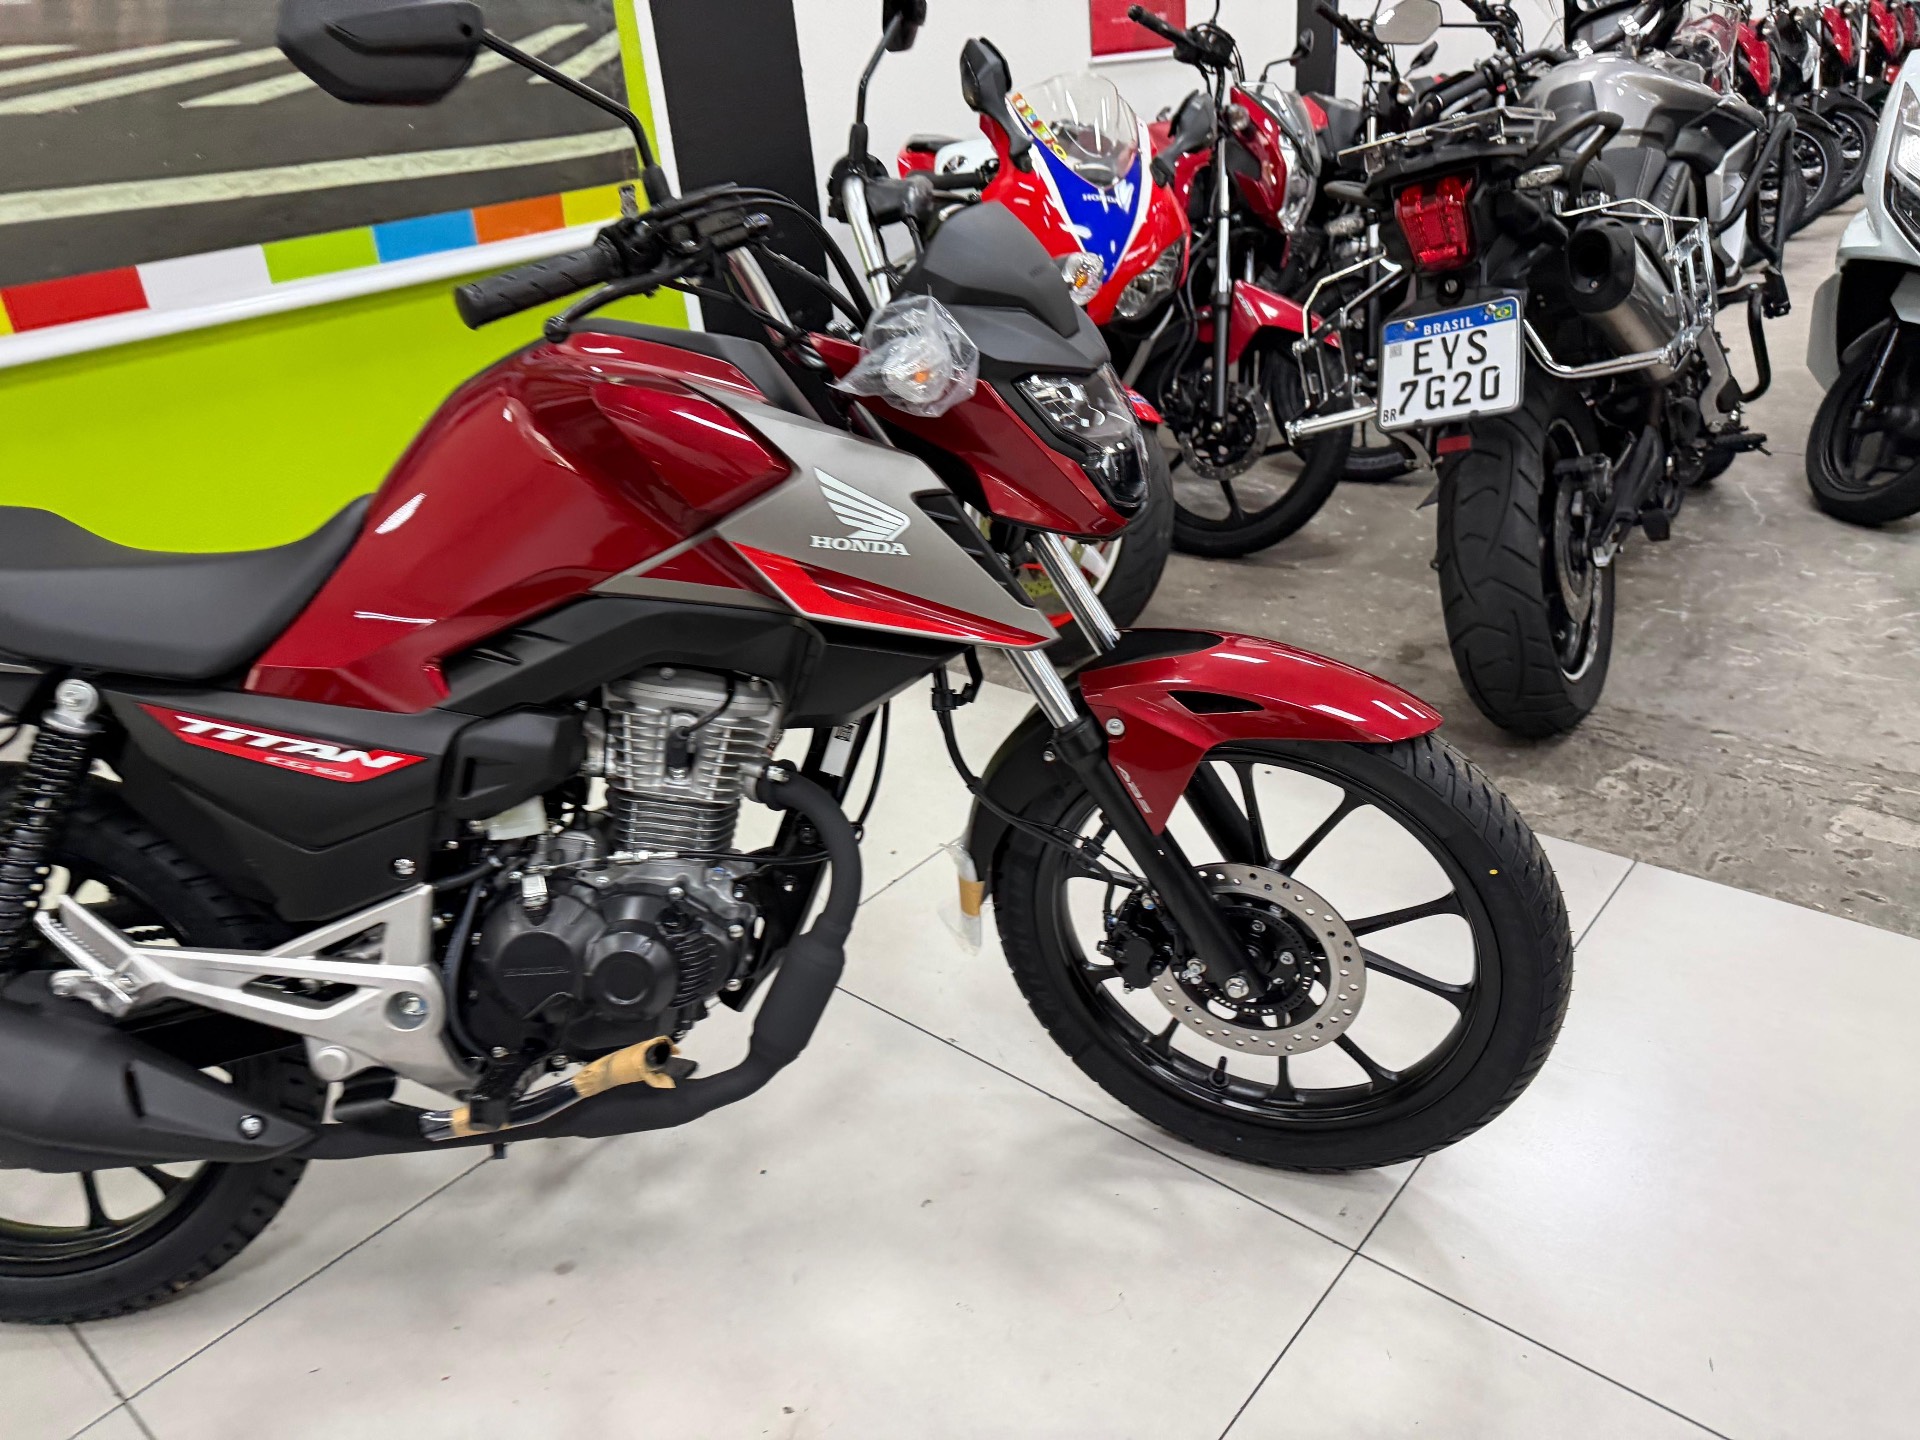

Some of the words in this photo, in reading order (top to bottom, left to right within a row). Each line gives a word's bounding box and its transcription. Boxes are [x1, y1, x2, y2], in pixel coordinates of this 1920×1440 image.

[1423, 316, 1474, 336] BRASIL
[1413, 329, 1488, 376] EYS
[1399, 365, 1501, 416] 7G20
[1383, 408, 1397, 423] BR
[809, 535, 912, 557] HONDA
[174, 715, 406, 769] TITAN
[1115, 764, 1153, 814] ABS
